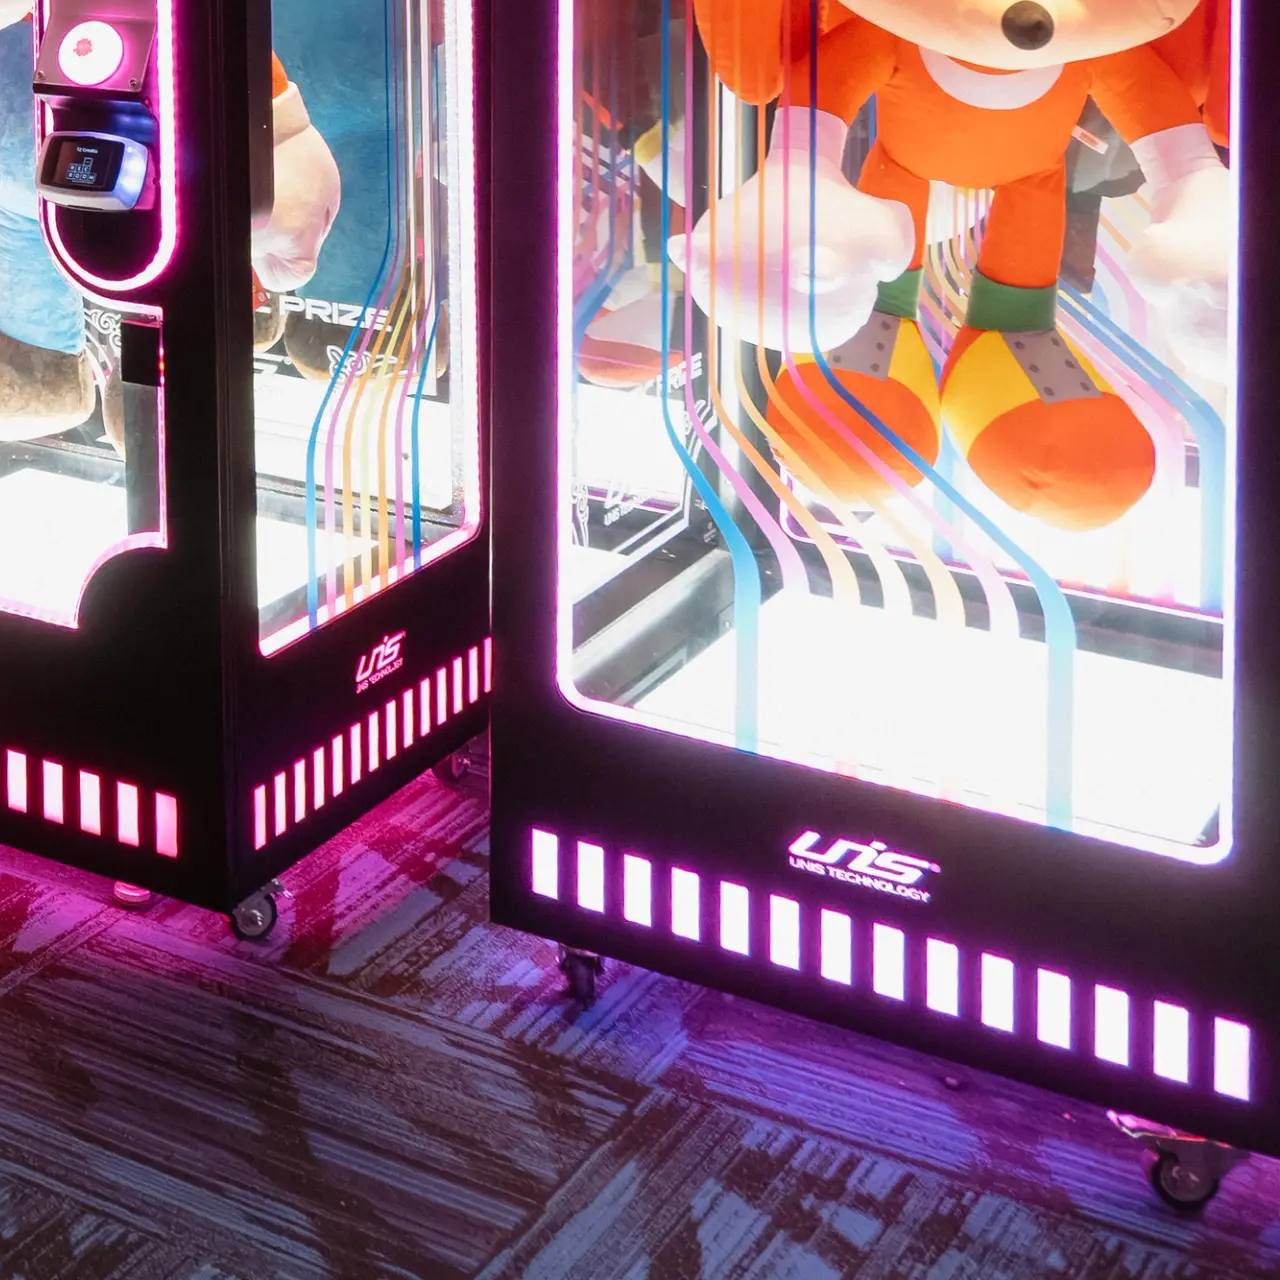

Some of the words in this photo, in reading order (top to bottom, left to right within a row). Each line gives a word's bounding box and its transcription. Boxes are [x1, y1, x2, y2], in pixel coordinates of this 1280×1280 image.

[279, 295, 392, 332] PRIZE
[789, 856, 825, 876] UNIS
[828, 867, 931, 904] TECHNOLOGY
